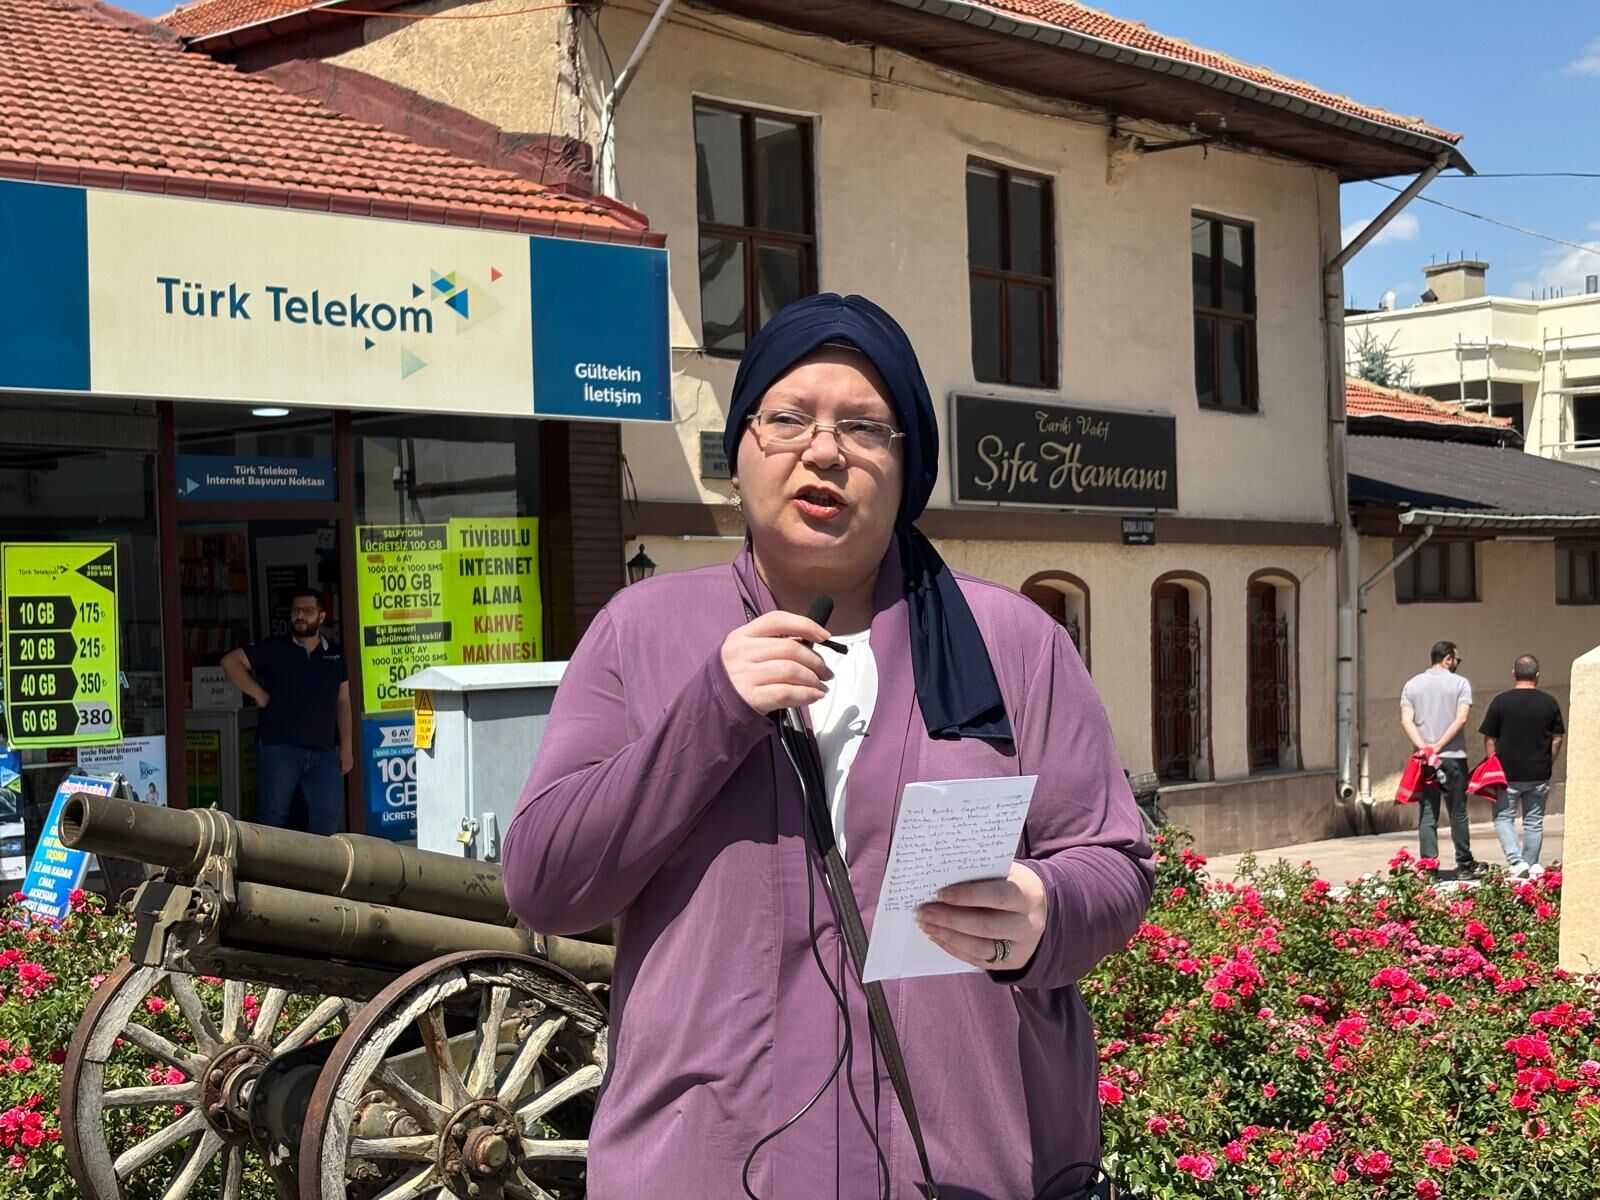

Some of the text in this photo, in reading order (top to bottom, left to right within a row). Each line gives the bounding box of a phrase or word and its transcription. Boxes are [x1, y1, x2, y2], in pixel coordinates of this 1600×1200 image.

[156, 275, 434, 334] Türk Telekom
[575, 362, 641, 382] Gültekin
[584, 382, 642, 407] İletişim
[1034, 410, 1072, 434] Tarihi
[234, 464, 298, 476] Türk Telekom
[974, 434, 1167, 493] Şifa Hamamı
[206, 473, 325, 487] İnternet Başvuru Noktası
[365, 539, 443, 552] ÜCRETSİZ 100 GB
[459, 525, 531, 548] TİVİBULU
[403, 554, 413, 562] AY
[459, 554, 533, 577] İNTERNET
[367, 565, 386, 574] 1000
[387, 565, 399, 573] DK
[407, 564, 426, 572] 1000
[427, 563, 444, 571] SMS
[380, 573, 432, 593] 100 GB
[372, 588, 442, 610] ÜCRETSİZ
[472, 585, 522, 606] ALANA
[19, 602, 35, 625] 10
[37, 602, 55, 625] GB
[388, 624, 417, 635] Benzeri
[473, 614, 524, 634] KAHVE
[422, 631, 442, 640] teklif
[20, 638, 35, 661] 20
[38, 637, 56, 661] GB
[417, 646, 427, 654] AY
[462, 637, 537, 664] MAKİNESİ
[371, 657, 391, 666] 1000
[392, 656, 404, 665] DK
[412, 654, 430, 663] 1000
[431, 653, 448, 661] SMS
[389, 665, 407, 683] 50
[21, 674, 36, 697] 40
[38, 673, 57, 696] GB
[22, 708, 113, 732] 60 GB 380
[391, 729, 398, 738] 6
[399, 728, 411, 737] AY
[80, 755, 93, 763] çok
[116, 746, 143, 754] internet
[383, 811, 417, 822] ÜCRETS
